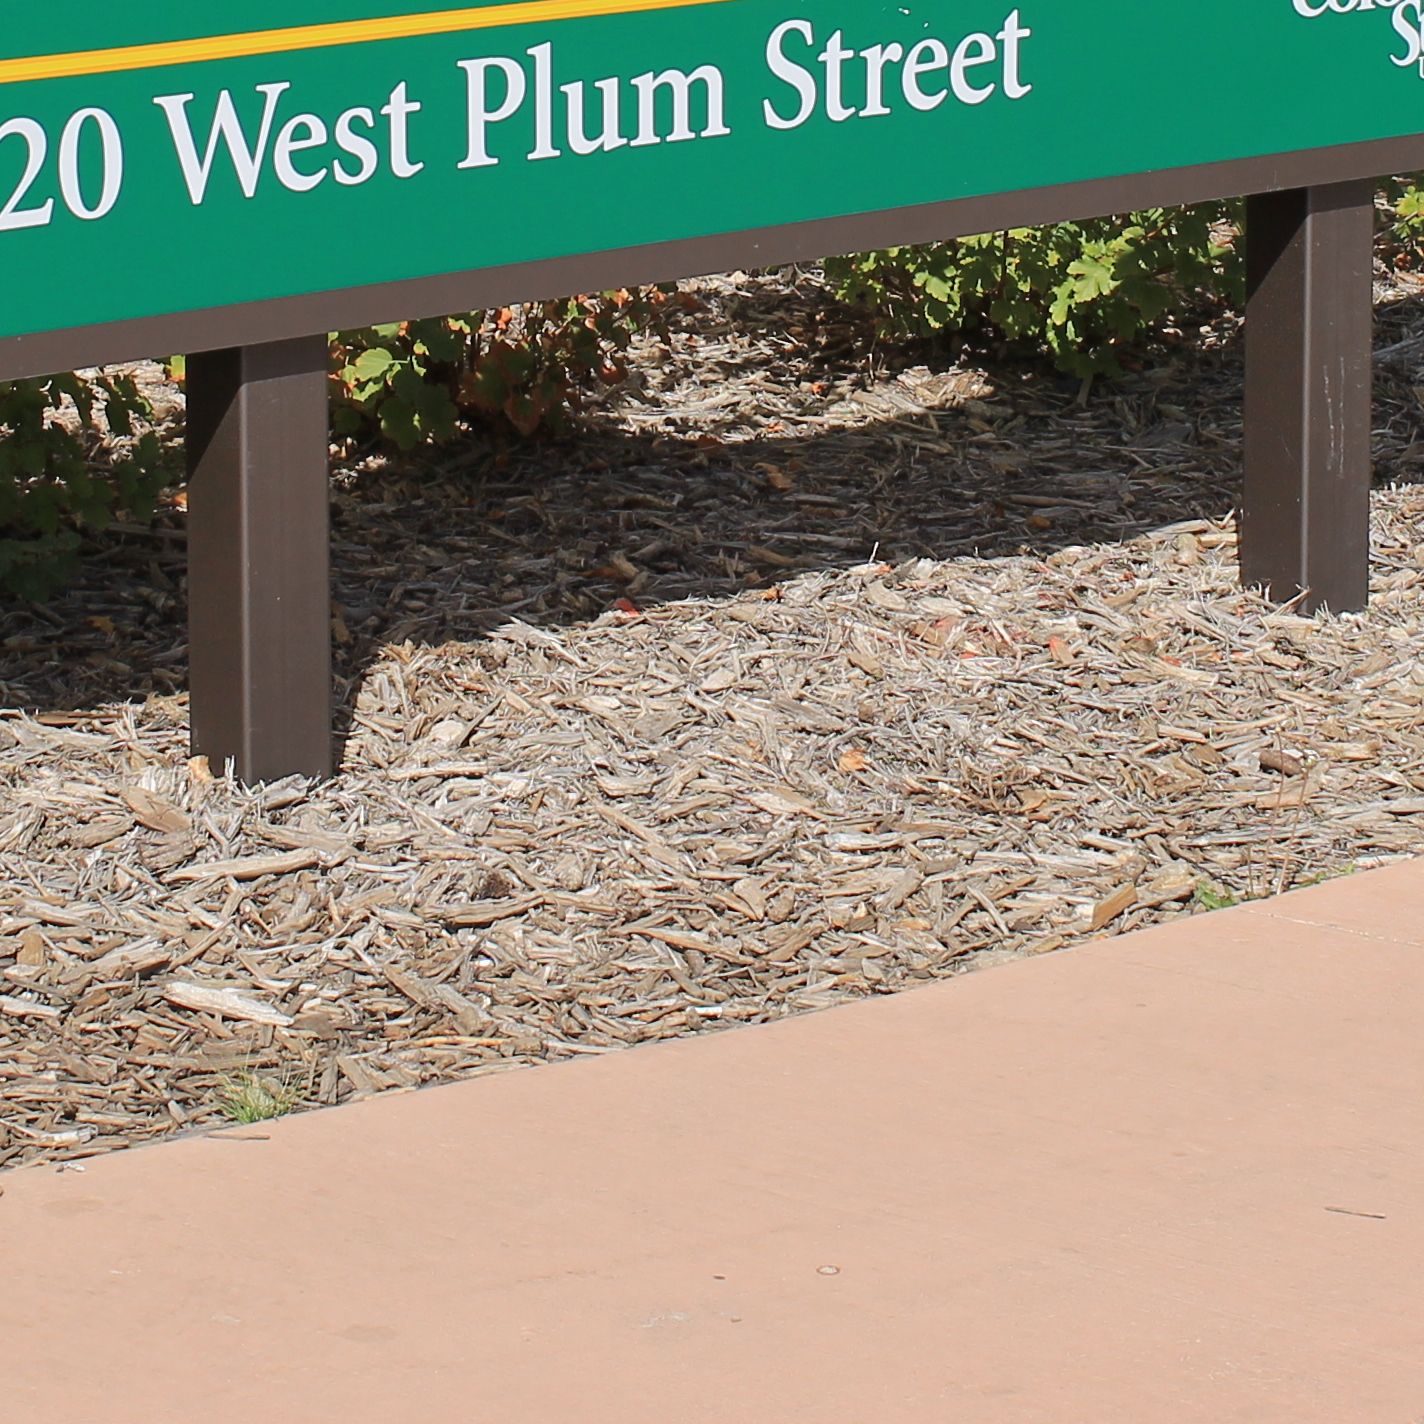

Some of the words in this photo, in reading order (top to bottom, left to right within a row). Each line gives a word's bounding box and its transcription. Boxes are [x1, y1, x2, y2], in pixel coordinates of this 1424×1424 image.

[152, 81, 426, 206] West
[456, 41, 732, 170] Plum
[762, 8, 1033, 130] Street
